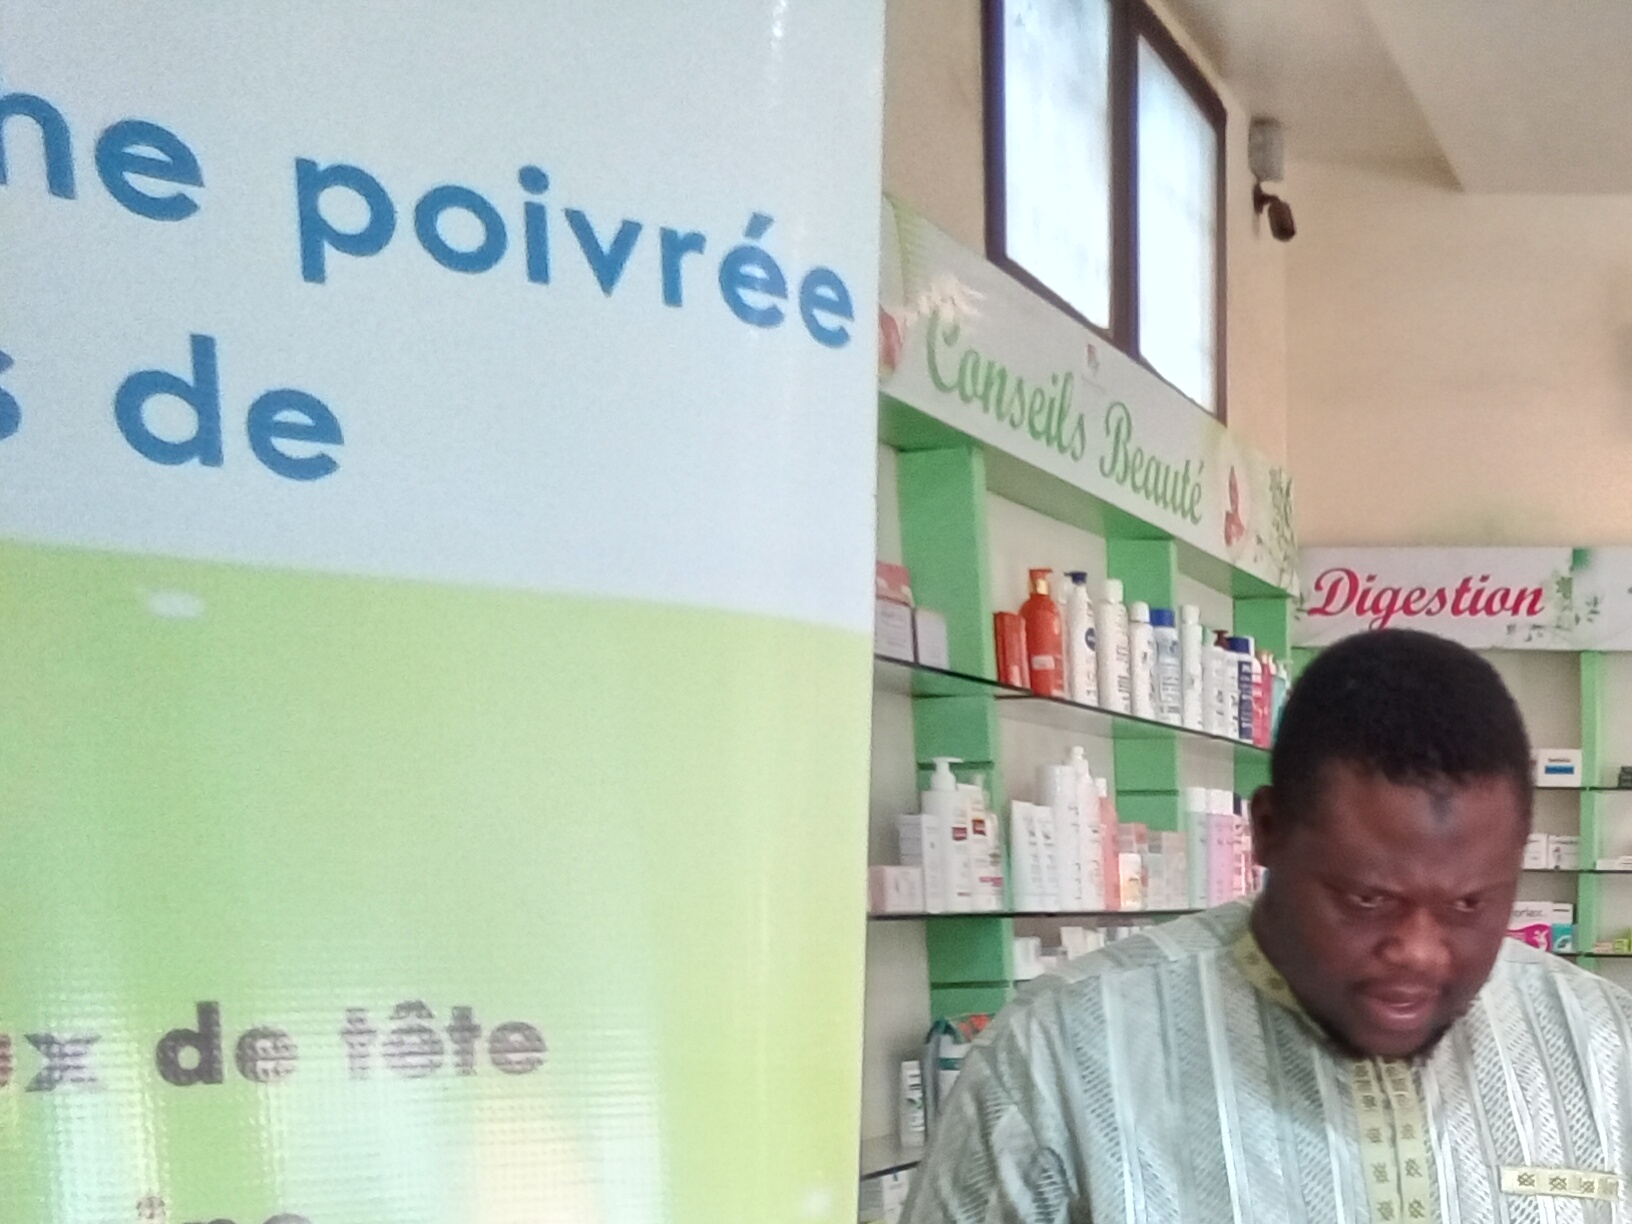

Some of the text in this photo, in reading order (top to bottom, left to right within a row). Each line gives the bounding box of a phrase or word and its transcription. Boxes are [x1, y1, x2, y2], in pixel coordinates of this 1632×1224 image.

[294, 157, 856, 348] poivrée
[113, 333, 345, 482] de
[925, 305, 1205, 526] Conseils Beauté
[1305, 566, 1545, 632] Digestion
[155, 1000, 299, 1087] de
[340, 1000, 549, 1080] tête
